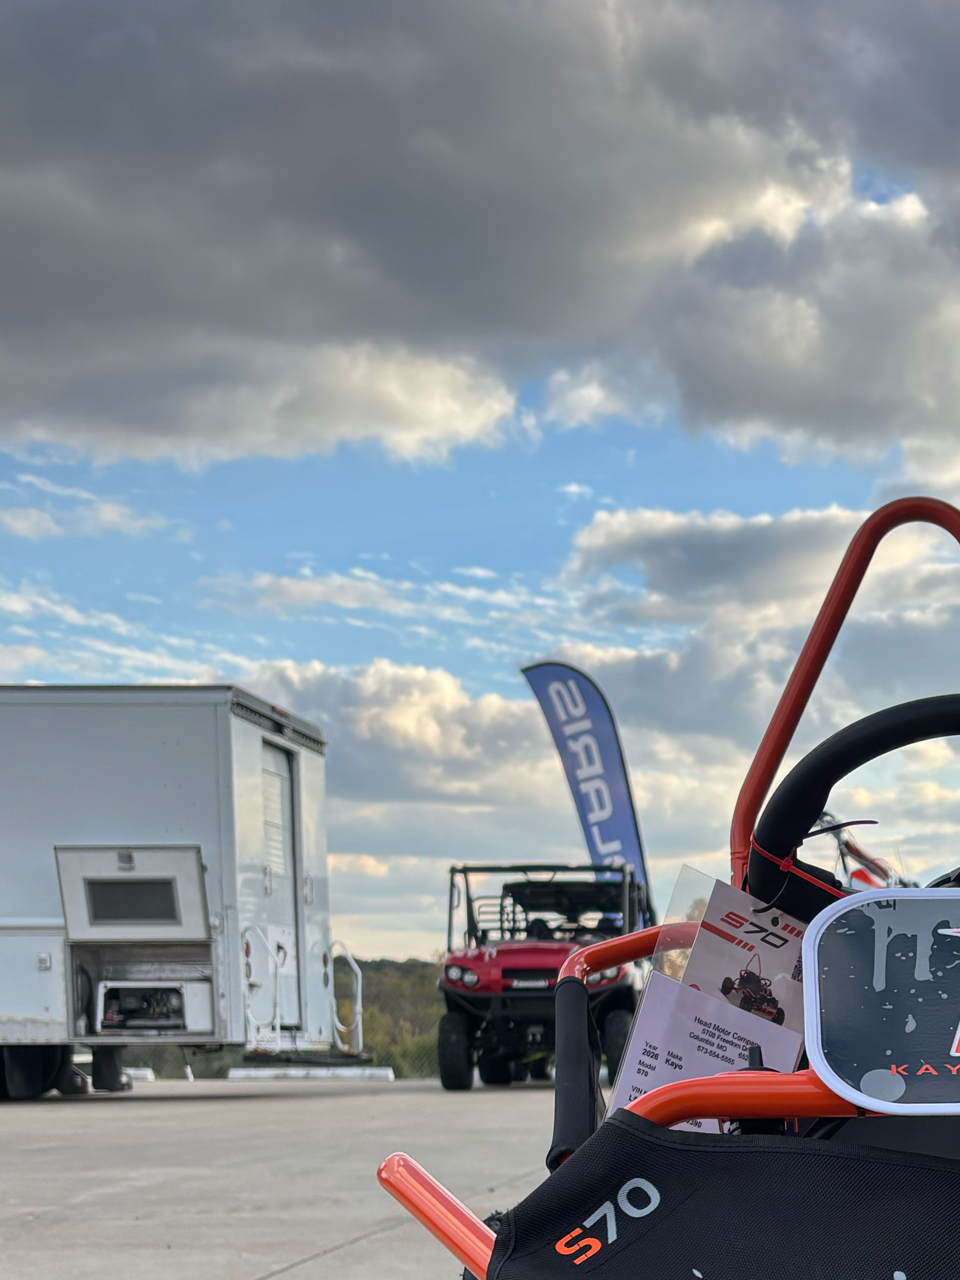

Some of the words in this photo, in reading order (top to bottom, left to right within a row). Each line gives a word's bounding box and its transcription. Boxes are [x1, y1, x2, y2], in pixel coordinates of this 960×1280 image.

[720, 911, 789, 949] S70
[713, 1024, 732, 1036] Motor
[645, 1041, 659, 1051] Year
[716, 1043, 728, 1052] MO
[717, 1034, 741, 1050] Freedom
[642, 1048, 660, 1061] 2026
[667, 1050, 683, 1062] Make
[638, 1059, 657, 1072] Model
[665, 1057, 684, 1071] Kayo
[554, 1177, 661, 1266] S70
